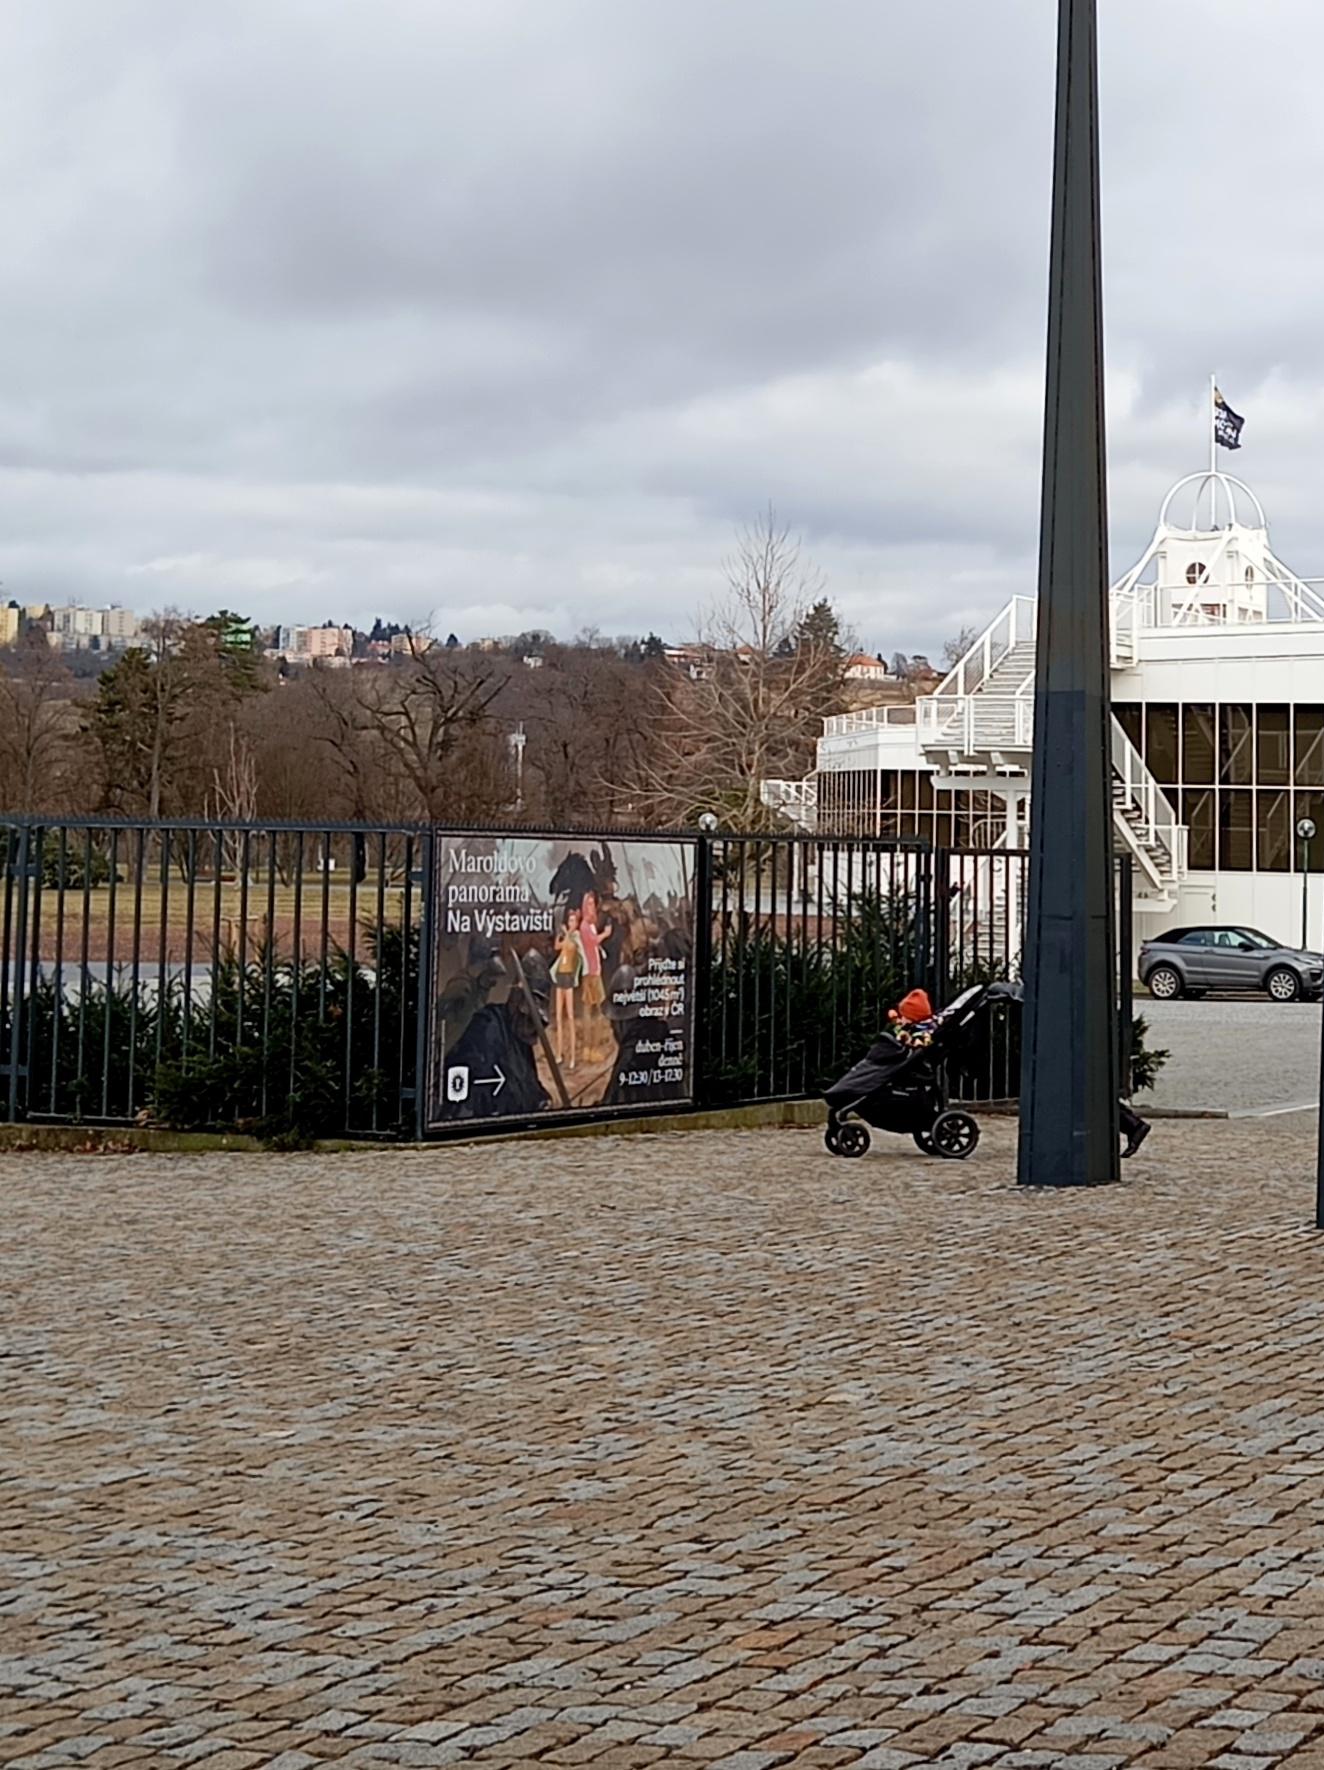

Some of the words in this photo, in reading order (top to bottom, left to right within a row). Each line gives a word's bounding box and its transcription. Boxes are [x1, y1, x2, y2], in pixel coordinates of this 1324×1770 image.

[448, 847, 536, 874] Maroldovo
[447, 908, 471, 933] Na
[474, 907, 554, 938] Výstavišti
